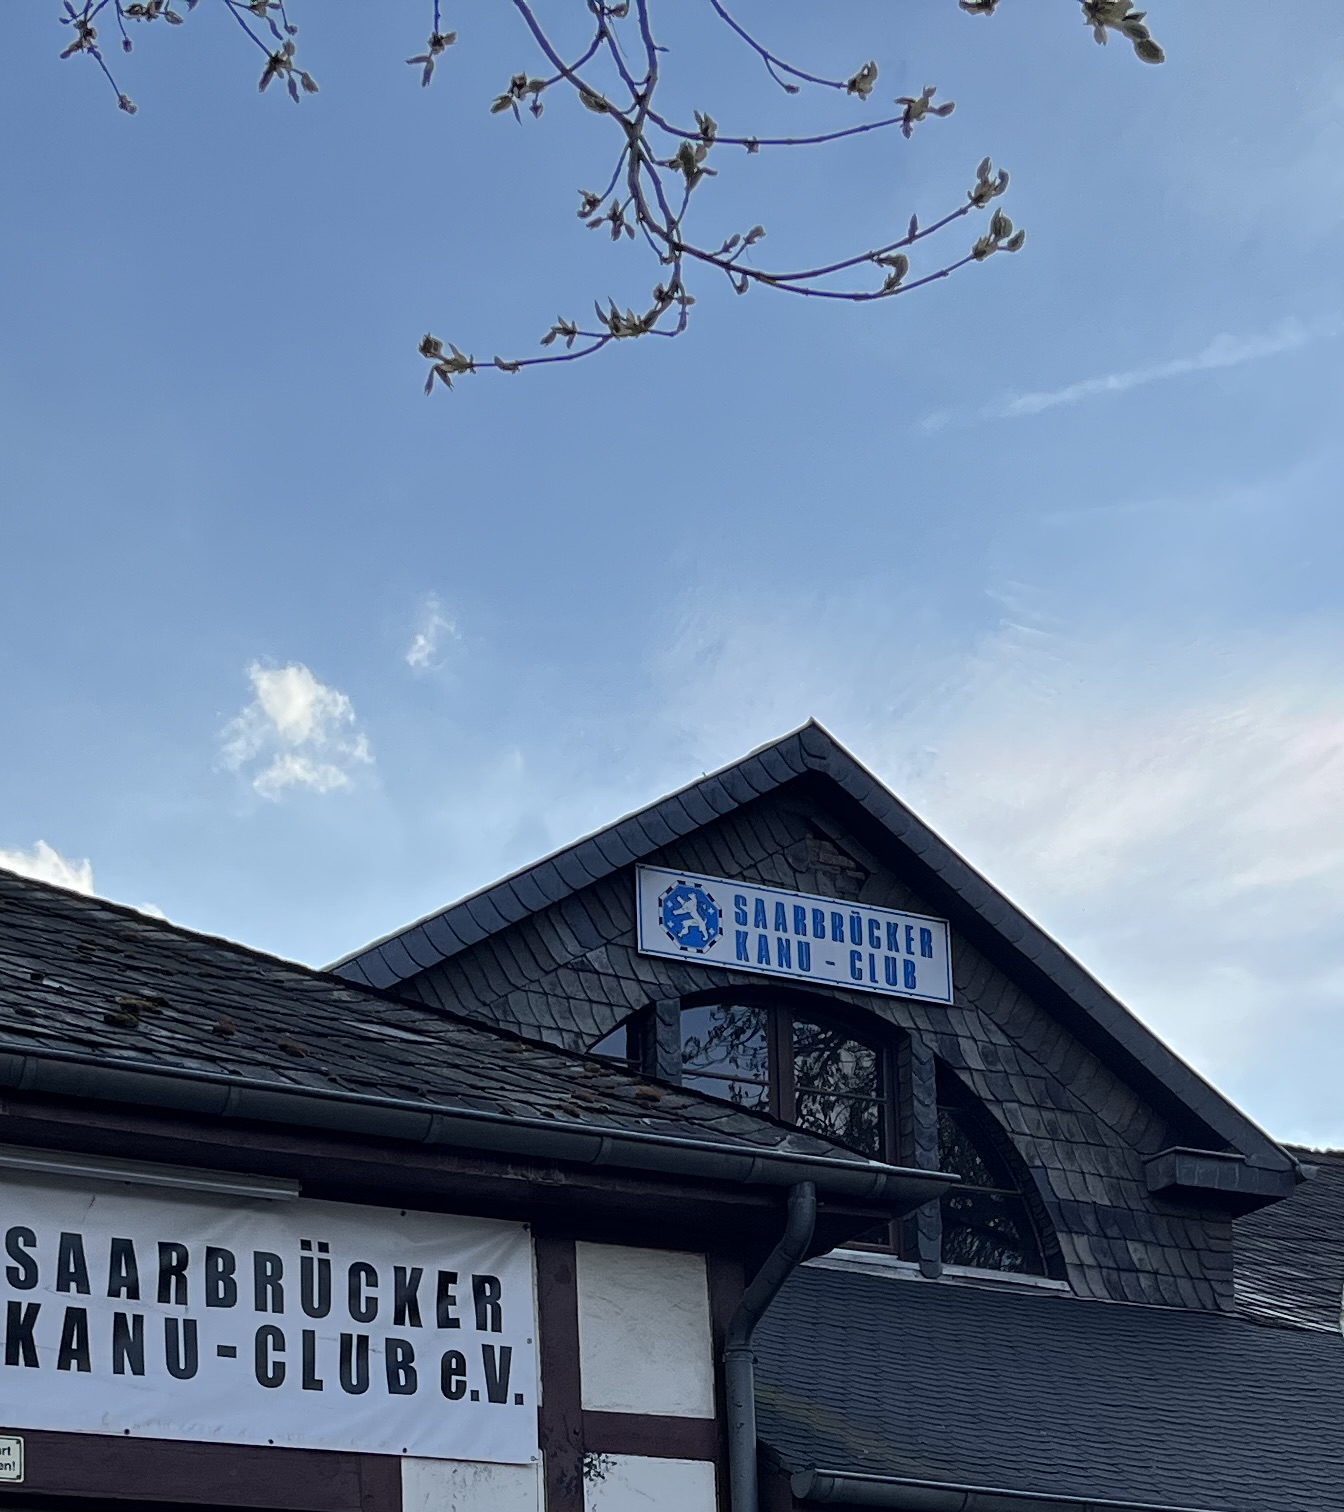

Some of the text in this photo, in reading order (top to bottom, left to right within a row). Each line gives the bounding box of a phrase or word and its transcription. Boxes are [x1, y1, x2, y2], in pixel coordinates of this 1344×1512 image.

[733, 894, 933, 958] SAARBRÜCKER
[734, 930, 812, 972] KANU
[849, 949, 918, 990] CLUB
[4, 1226, 503, 1333] SAARBRÜCKER
[4, 1300, 525, 1406] KANU-CLUB e.V.
